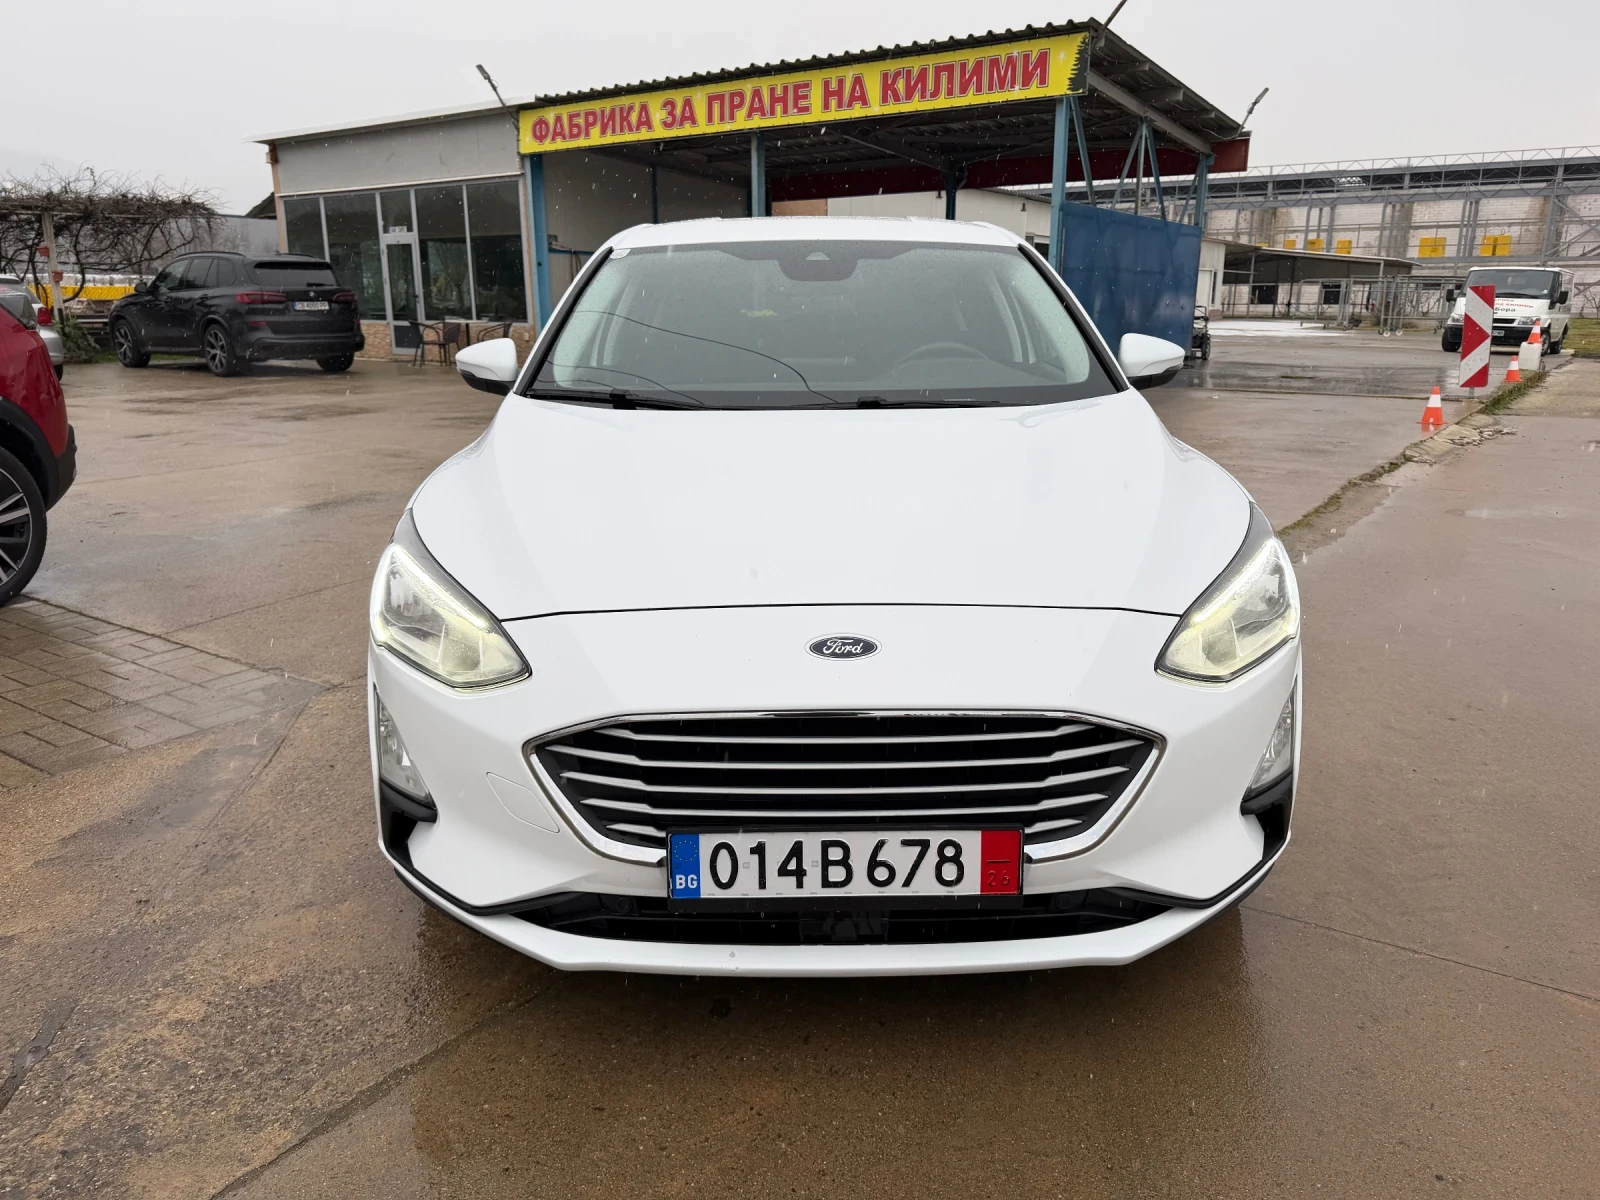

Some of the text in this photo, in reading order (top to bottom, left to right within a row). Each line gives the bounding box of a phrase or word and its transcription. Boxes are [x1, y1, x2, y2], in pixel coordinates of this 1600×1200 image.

[531, 48, 1051, 144] ФАБРИКА ЗА ПРАНЕ НА КИЛИМИ
[823, 639, 864, 654] Ford
[675, 874, 698, 889] BG
[987, 870, 1011, 887] 26
